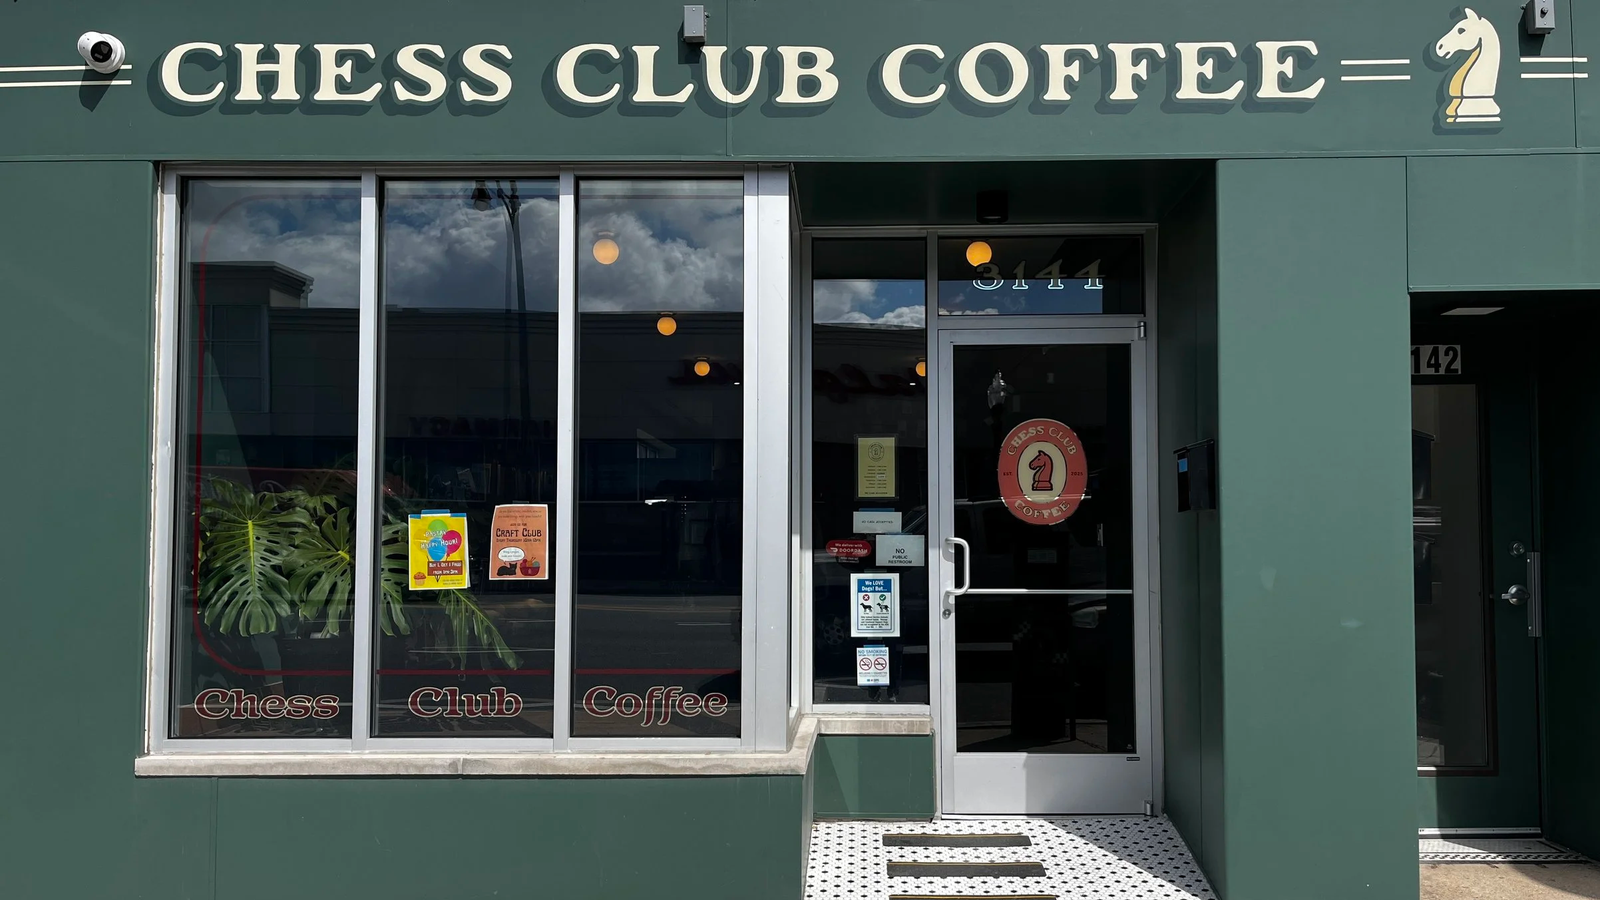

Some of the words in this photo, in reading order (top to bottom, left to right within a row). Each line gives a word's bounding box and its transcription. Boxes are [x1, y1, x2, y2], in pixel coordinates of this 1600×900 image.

[161, 41, 513, 104] CHESS
[556, 43, 840, 104] CLUB
[881, 40, 1326, 105] COFFEE
[972, 258, 1107, 291] 3144
[1007, 425, 1045, 456] CHESS
[1048, 426, 1078, 455] CLUB
[1014, 499, 1070, 519] COFFEE
[495, 527, 519, 538] CRAFT
[522, 527, 542, 538] CLUB
[194, 687, 340, 720] Chess
[407, 686, 523, 719] Club
[582, 685, 728, 728] Coffee
